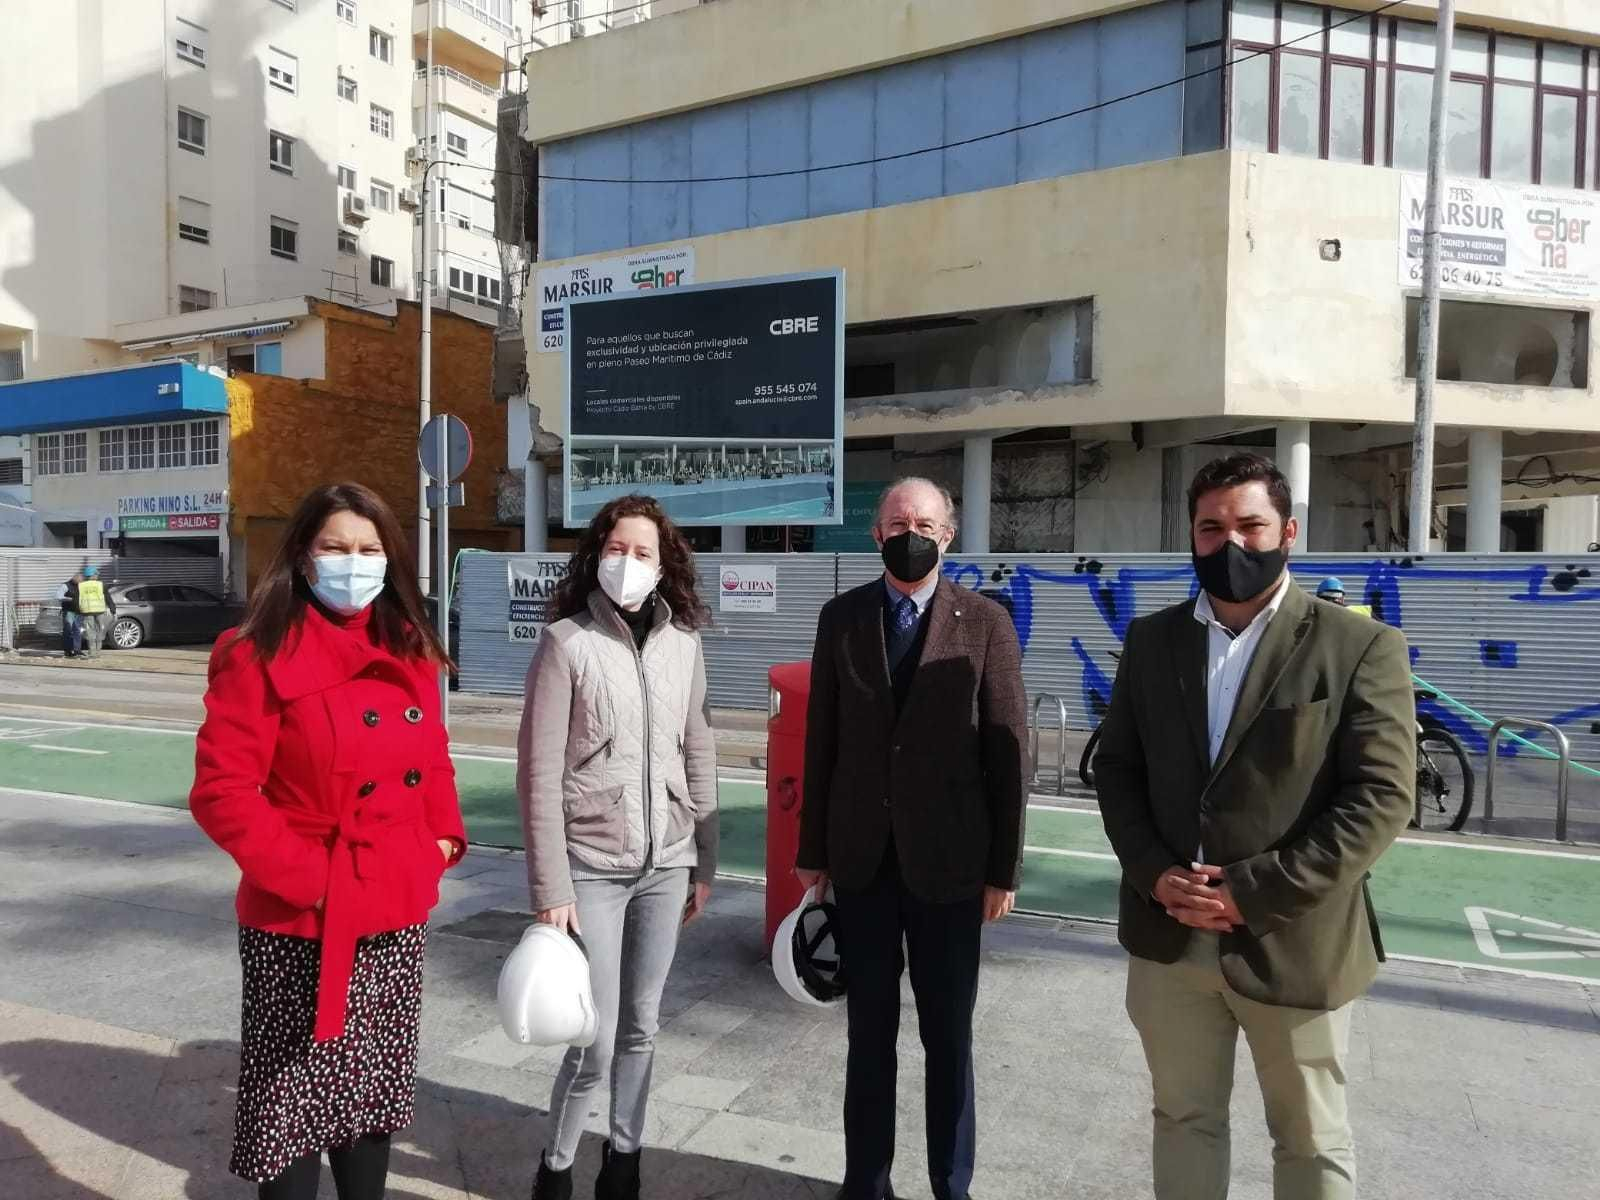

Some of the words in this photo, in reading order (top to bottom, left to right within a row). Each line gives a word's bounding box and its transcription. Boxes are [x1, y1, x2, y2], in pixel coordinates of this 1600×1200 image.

[1411, 198, 1505, 231] MRSUR
[1442, 267, 1459, 283] 06
[1463, 269, 1481, 285] 40
[1486, 271, 1504, 287] 75
[544, 278, 613, 303] MARSUR
[769, 316, 819, 335] CBRE
[544, 335, 563, 348] 620
[586, 335, 605, 346] Para
[607, 333, 643, 345] aquellos
[644, 332, 661, 342] que
[663, 329, 695, 340] buscan
[586, 344, 639, 357] exclusividad
[649, 340, 692, 352] ubicación
[694, 336, 748, 350] privilegiada
[586, 361, 597, 369] en
[599, 357, 623, 369] pleno
[624, 356, 650, 366] Paseo
[693, 351, 705, 361] de
[706, 348, 733, 360] Cádiz
[754, 385, 773, 396] 955
[776, 383, 795, 394] 545
[798, 381, 817, 393] 074
[118, 497, 156, 514] PARKING
[184, 495, 201, 511] S.L.
[203, 493, 222, 505] 24H
[127, 519, 161, 530] ENTRADA
[177, 516, 208, 528] SALIDA
[514, 578, 556, 598] MAR
[740, 581, 773, 591] CIPAN
[514, 625, 537, 639] 620
